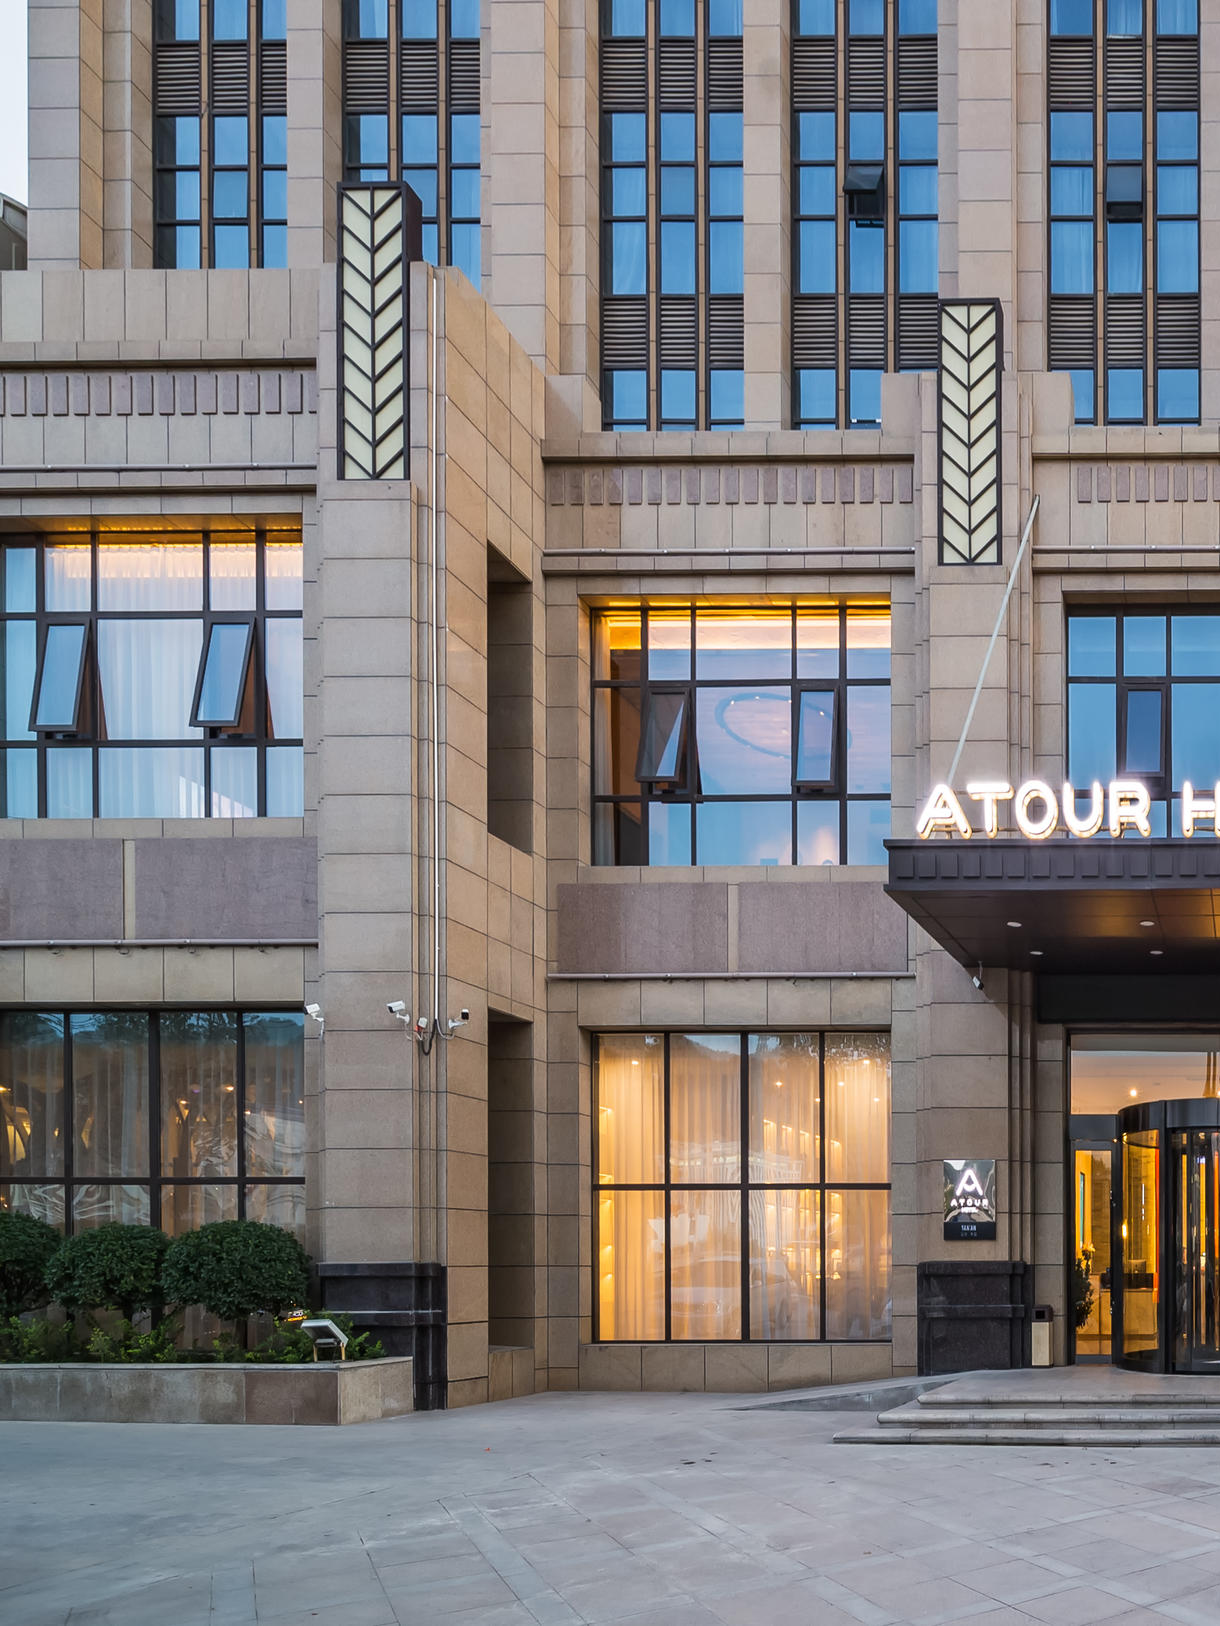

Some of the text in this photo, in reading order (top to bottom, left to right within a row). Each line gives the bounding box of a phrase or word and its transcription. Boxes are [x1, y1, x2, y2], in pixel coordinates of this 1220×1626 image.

[916, 780, 1151, 840] ATOUR
[955, 1169, 983, 1196] A
[950, 1198, 988, 1207] ATOUR
